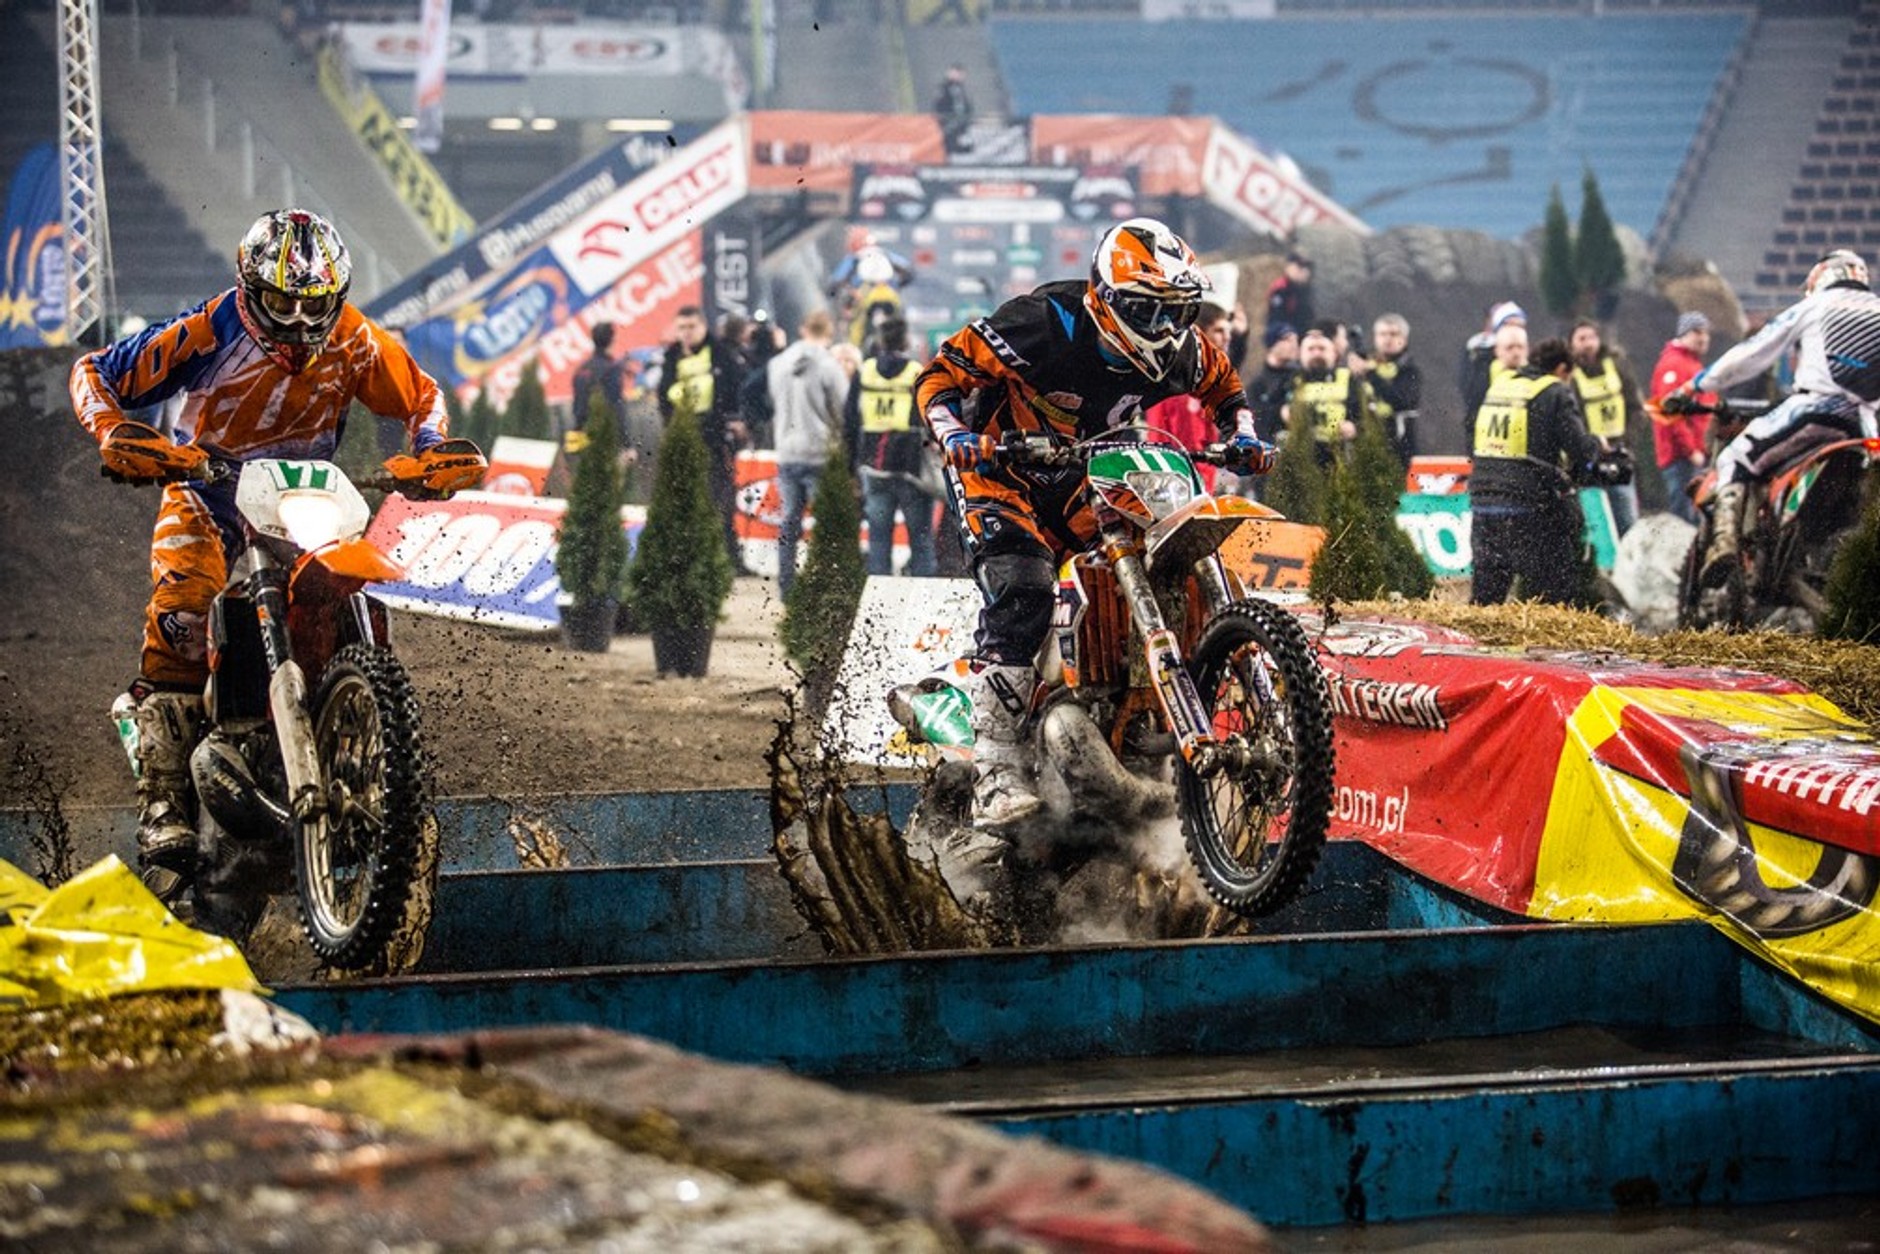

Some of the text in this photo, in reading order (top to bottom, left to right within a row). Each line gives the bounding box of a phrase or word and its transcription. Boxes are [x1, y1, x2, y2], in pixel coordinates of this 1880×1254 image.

[876, 397, 894, 419] M
[1488, 414, 1510, 440] M
[1121, 448, 1173, 473] 11
